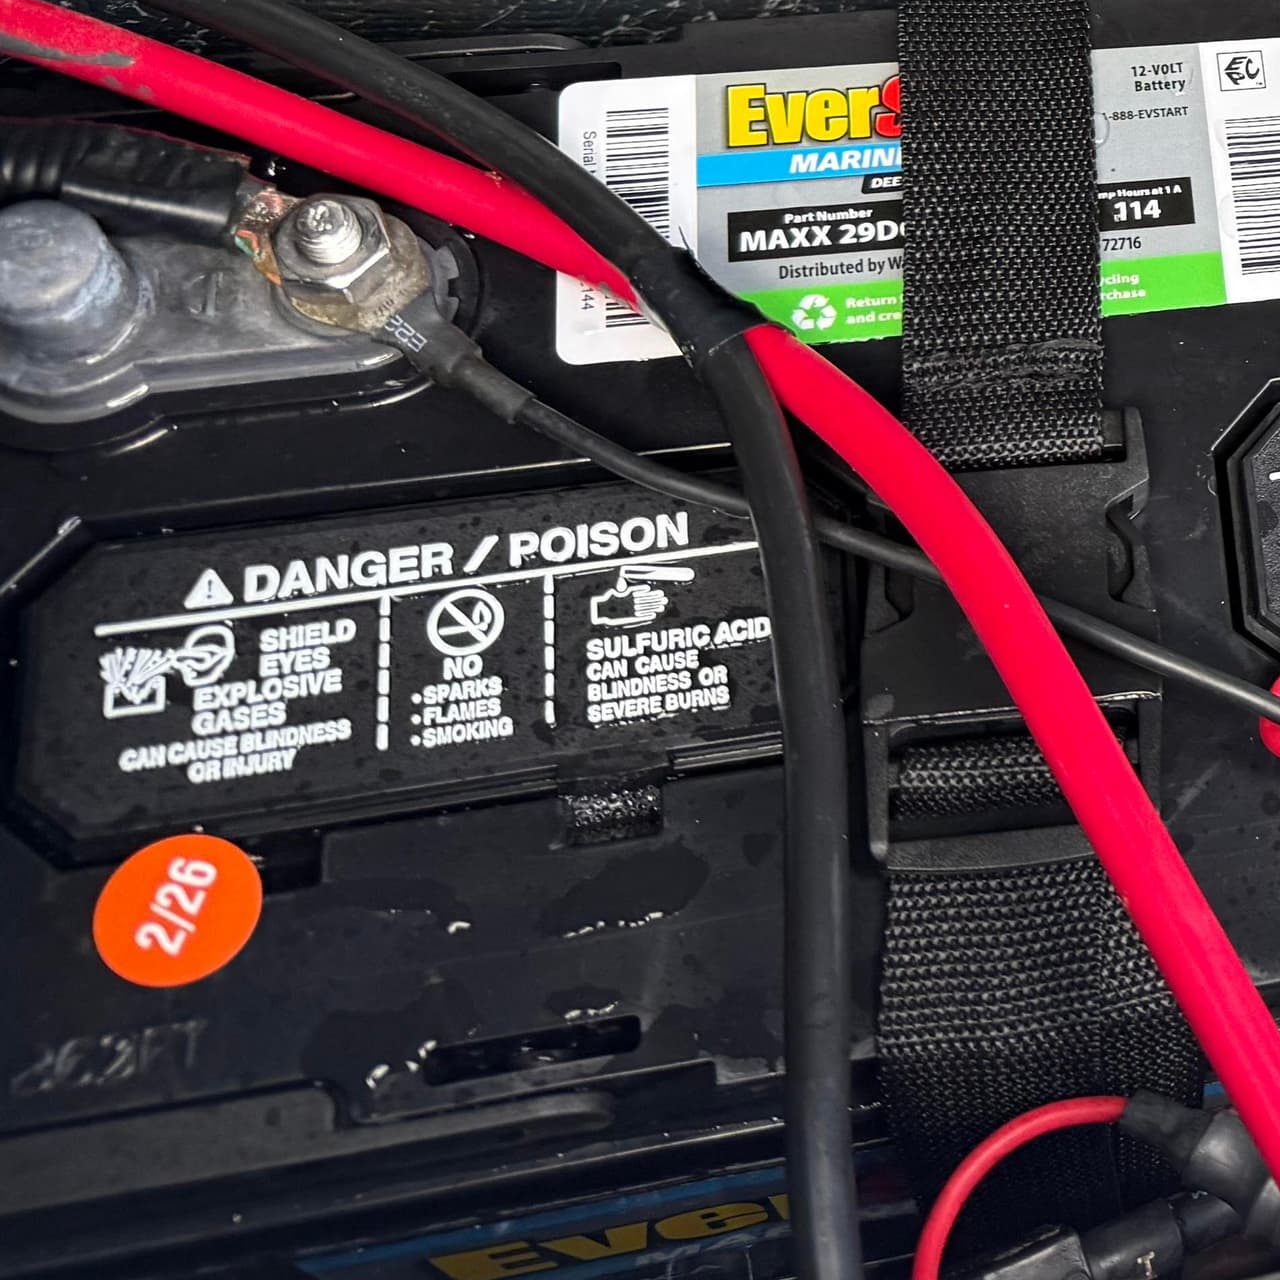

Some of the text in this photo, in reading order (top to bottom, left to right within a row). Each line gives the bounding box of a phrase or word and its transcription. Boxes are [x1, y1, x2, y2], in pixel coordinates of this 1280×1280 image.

[1131, 62, 1183, 77] 12-VOLT
[1134, 78, 1186, 93] Battery
[727, 74, 902, 149] EverS
[1101, 107, 1189, 121] 1-888-EVSTART
[583, 131, 597, 167] Serial
[870, 175, 903, 190] DEE
[1098, 192, 1116, 200] mp
[1117, 188, 1150, 197] Hours
[1151, 186, 1163, 195] at
[1173, 184, 1182, 193] A
[784, 208, 873, 224] Part Number
[1114, 200, 1162, 222] 114
[740, 220, 906, 253] MAXX 29D
[1101, 236, 1143, 252] 72716
[779, 258, 864, 280] Distributed
[868, 258, 885, 274] by
[1101, 273, 1139, 287] cling
[579, 278, 595, 311] 144
[846, 295, 897, 308] Return
[1100, 288, 1147, 300] rchase
[846, 311, 902, 325] and cre
[242, 542, 454, 603] DANGER
[508, 512, 689, 568] POISON
[258, 618, 357, 653] SHIELD
[586, 617, 772, 661] SULFURIC ACID
[258, 646, 331, 679] EYES
[443, 654, 484, 680] NO
[586, 649, 699, 682] CAN CAUSE
[192, 668, 344, 712] EXPLOSIVE
[423, 675, 503, 705] SPARKS
[587, 665, 728, 702] BLINDNESS OR
[191, 702, 287, 737] GASES
[423, 698, 502, 726] FLAMES
[587, 684, 730, 723] SEVERE BURNS
[118, 718, 352, 772] CAN CAUSE BLINDNESS
[422, 716, 514, 748] SMOKING
[186, 749, 298, 785] OR INJURY
[134, 856, 218, 957] 2/26
